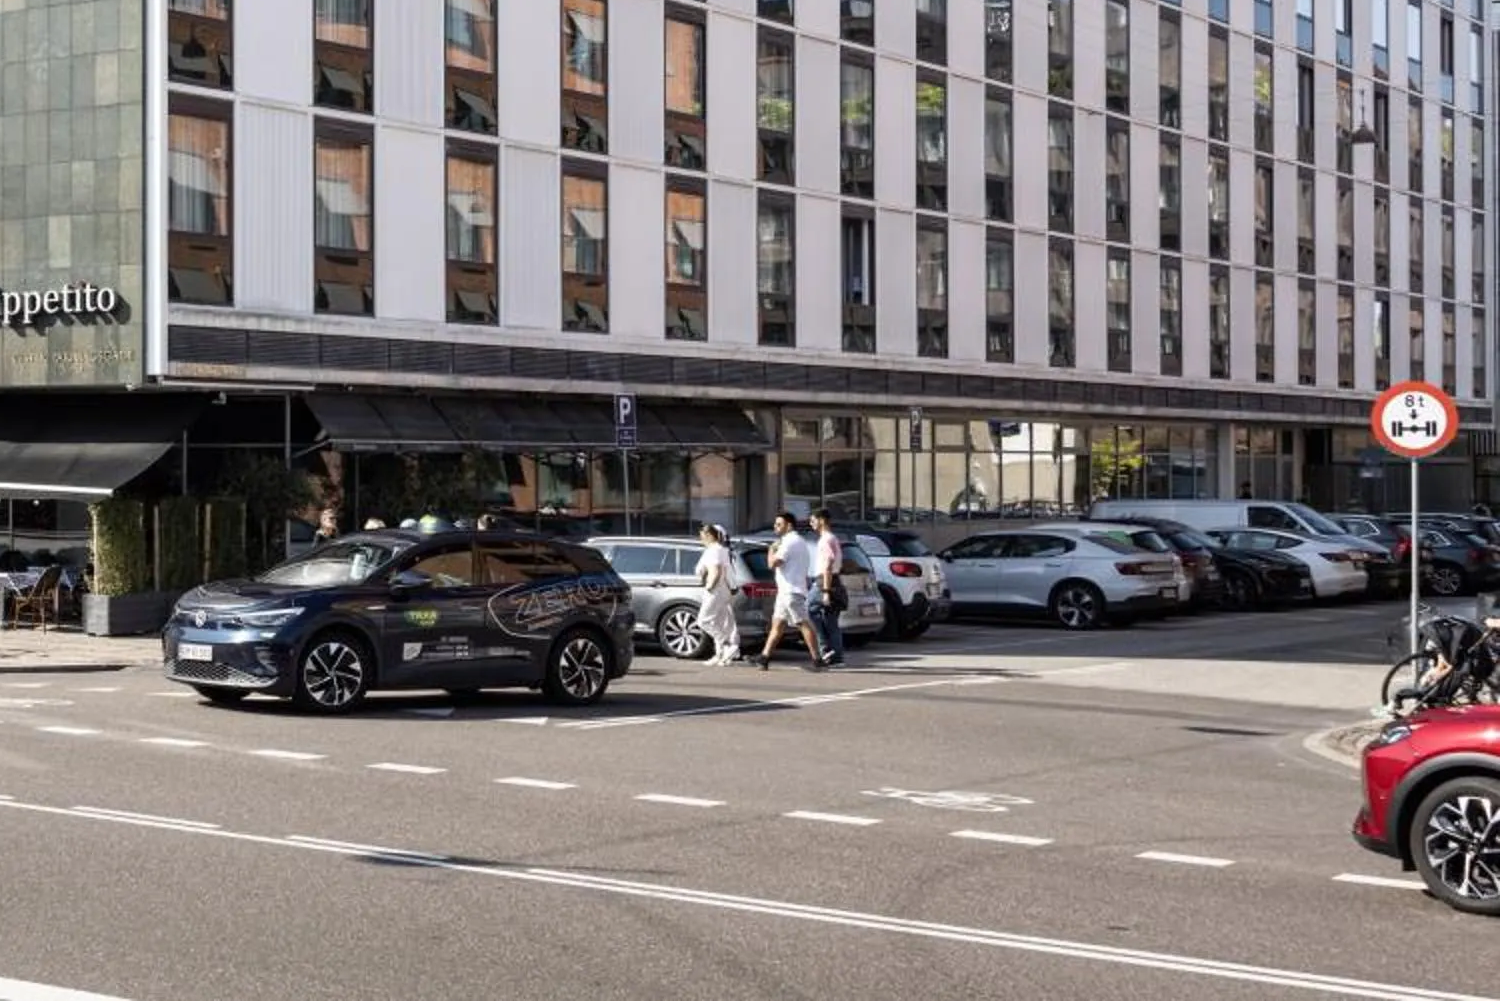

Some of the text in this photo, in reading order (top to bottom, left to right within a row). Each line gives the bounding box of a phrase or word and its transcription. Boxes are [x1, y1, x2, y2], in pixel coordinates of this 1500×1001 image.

[619, 396, 631, 424] P
[1404, 394, 1425, 408] 8 t
